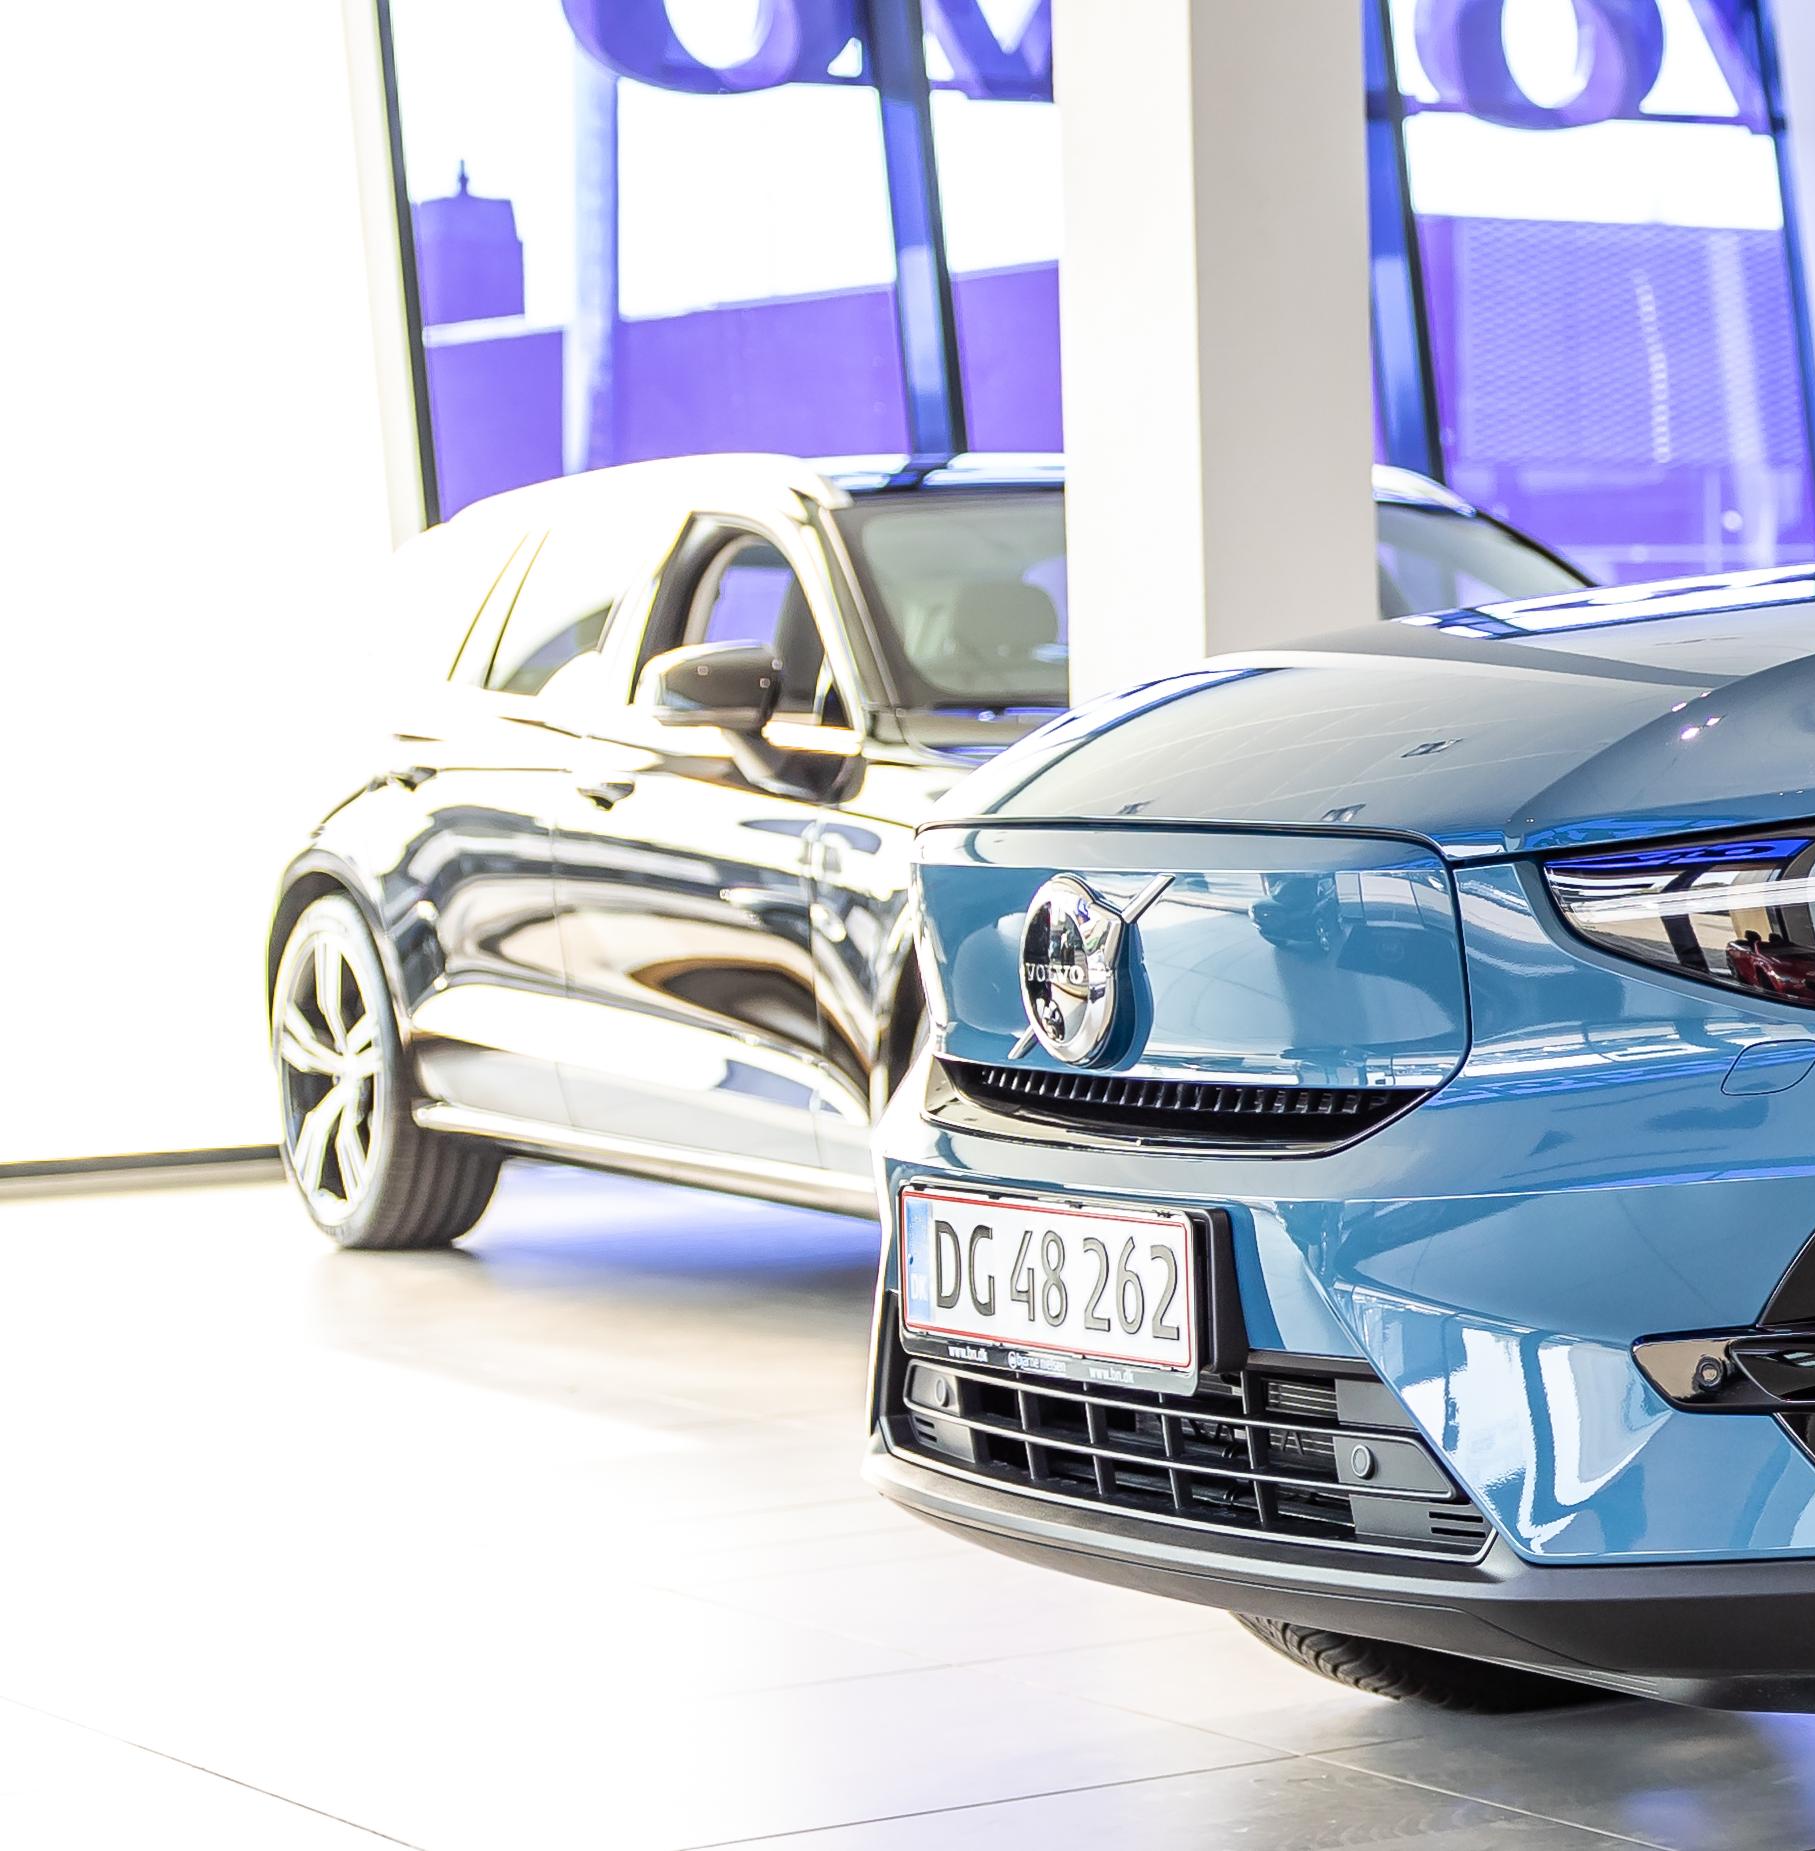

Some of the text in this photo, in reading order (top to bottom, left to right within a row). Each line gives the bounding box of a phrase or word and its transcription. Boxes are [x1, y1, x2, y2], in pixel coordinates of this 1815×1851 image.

[1025, 963, 1085, 985] VOLVO
[934, 1220, 1181, 1342] DG 48 262
